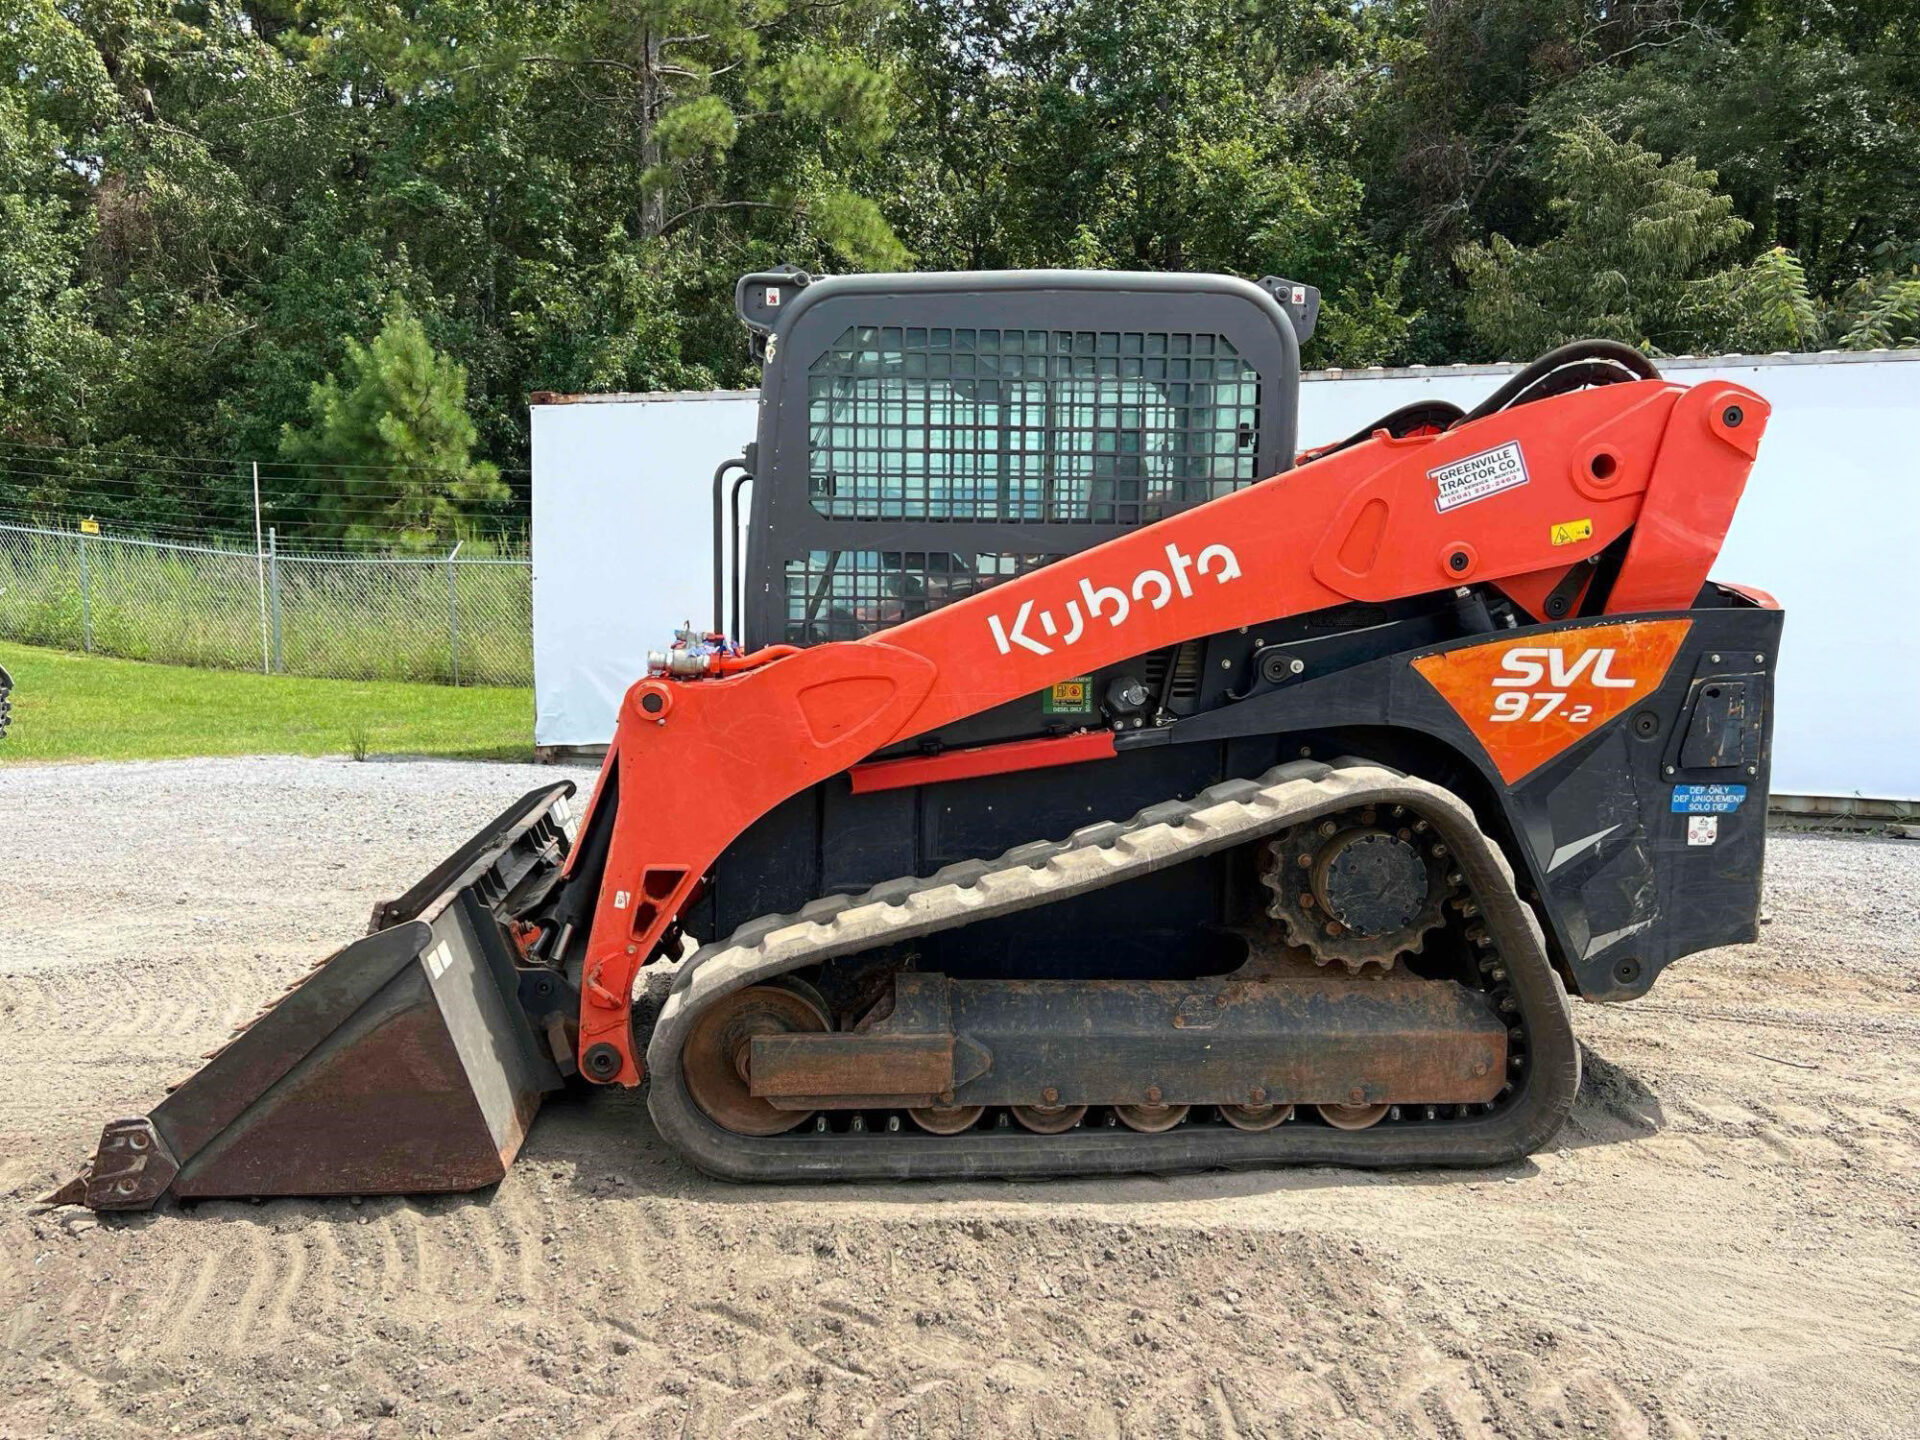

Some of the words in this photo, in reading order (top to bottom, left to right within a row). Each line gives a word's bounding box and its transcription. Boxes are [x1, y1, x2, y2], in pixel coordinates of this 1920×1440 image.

[1439, 449, 1512, 481] GREENVILLE
[1440, 466, 1496, 492] TRACTOR
[1498, 459, 1516, 472] CO
[1464, 479, 1489, 491] SERVICE
[1494, 467, 1521, 480] RENTALS
[987, 543, 1242, 656] Kubota
[1491, 648, 1637, 688] SVL
[1489, 691, 1593, 723] 97-2
[1673, 794, 1689, 803] DEF
[1688, 802, 1710, 811] SOLO
[1712, 802, 1728, 811] DEF
[1689, 786, 1705, 795] DEF
[1708, 786, 1730, 795] ONLY
